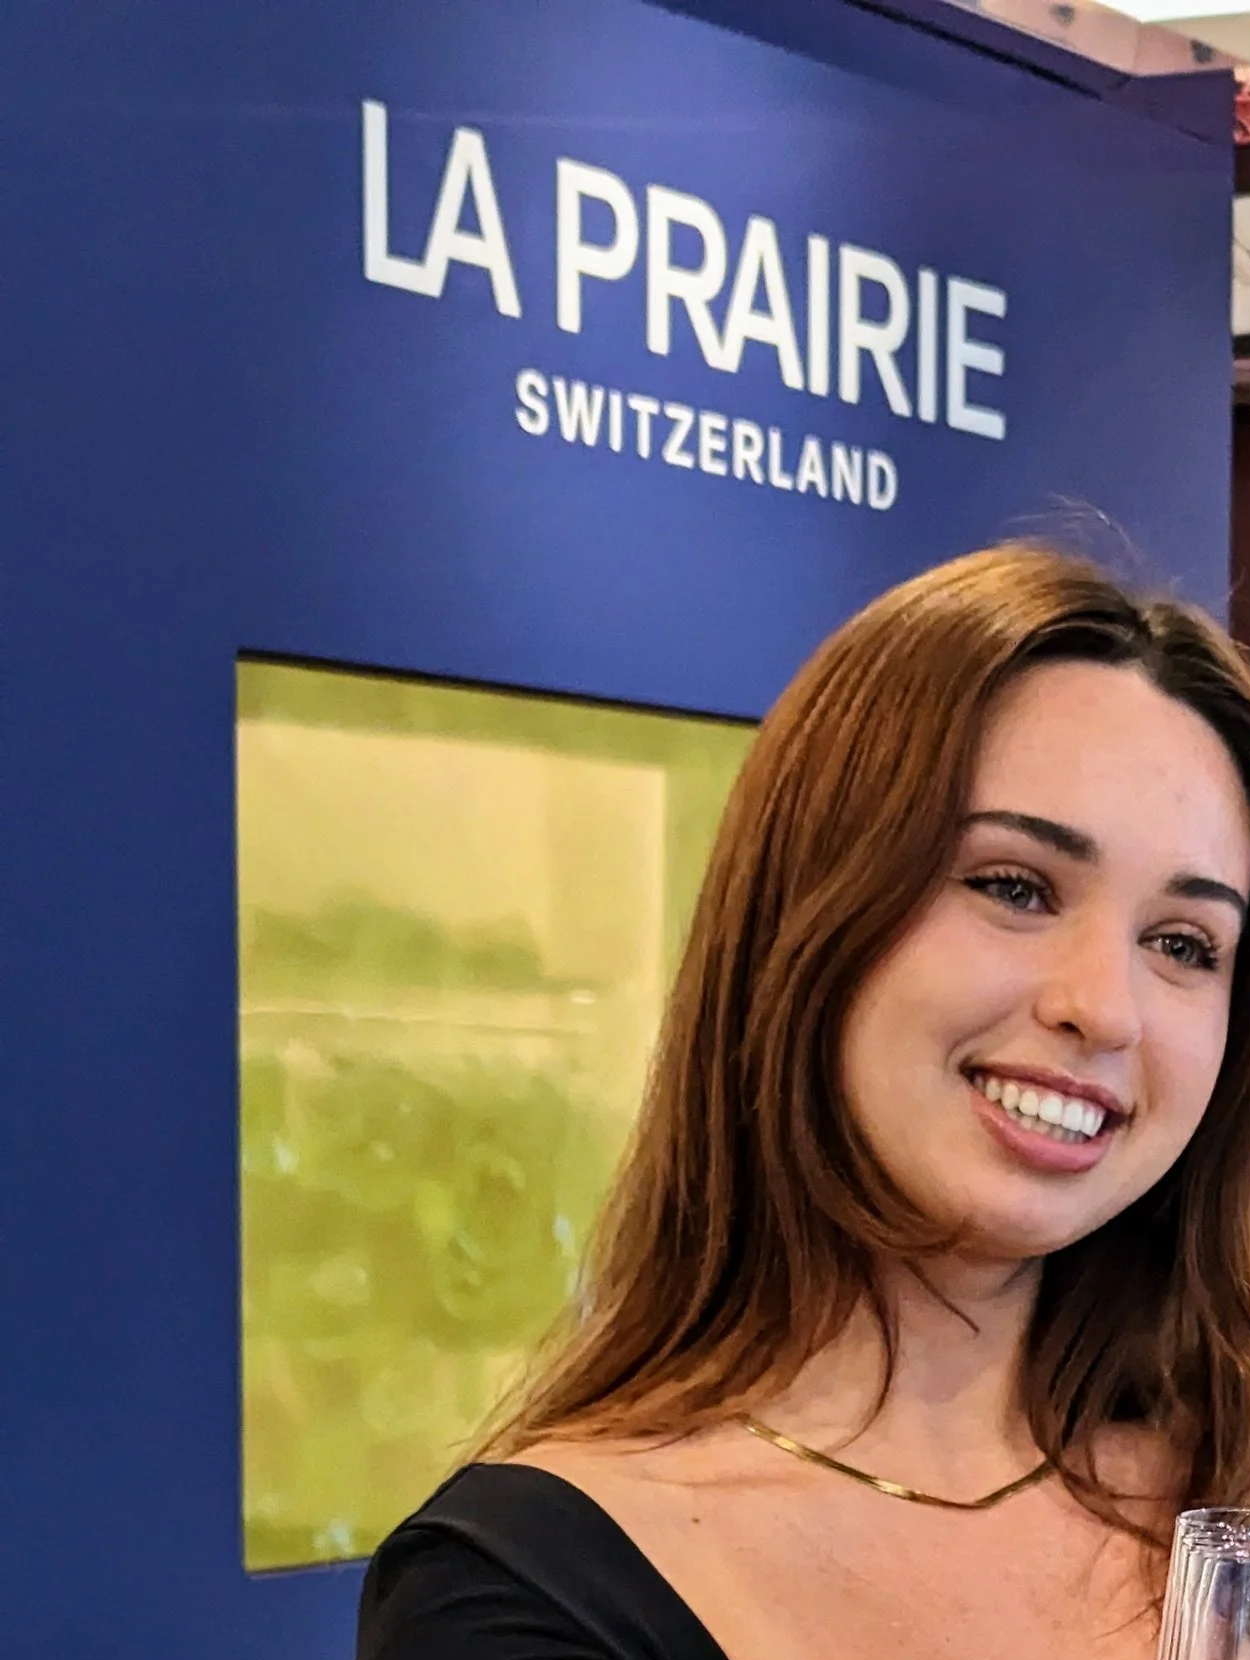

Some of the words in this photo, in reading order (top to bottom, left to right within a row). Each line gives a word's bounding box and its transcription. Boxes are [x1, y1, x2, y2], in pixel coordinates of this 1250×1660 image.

[361, 99, 522, 319] LA
[555, 156, 1006, 441] PRAIRIE
[514, 367, 898, 511] SWITZERLAND
